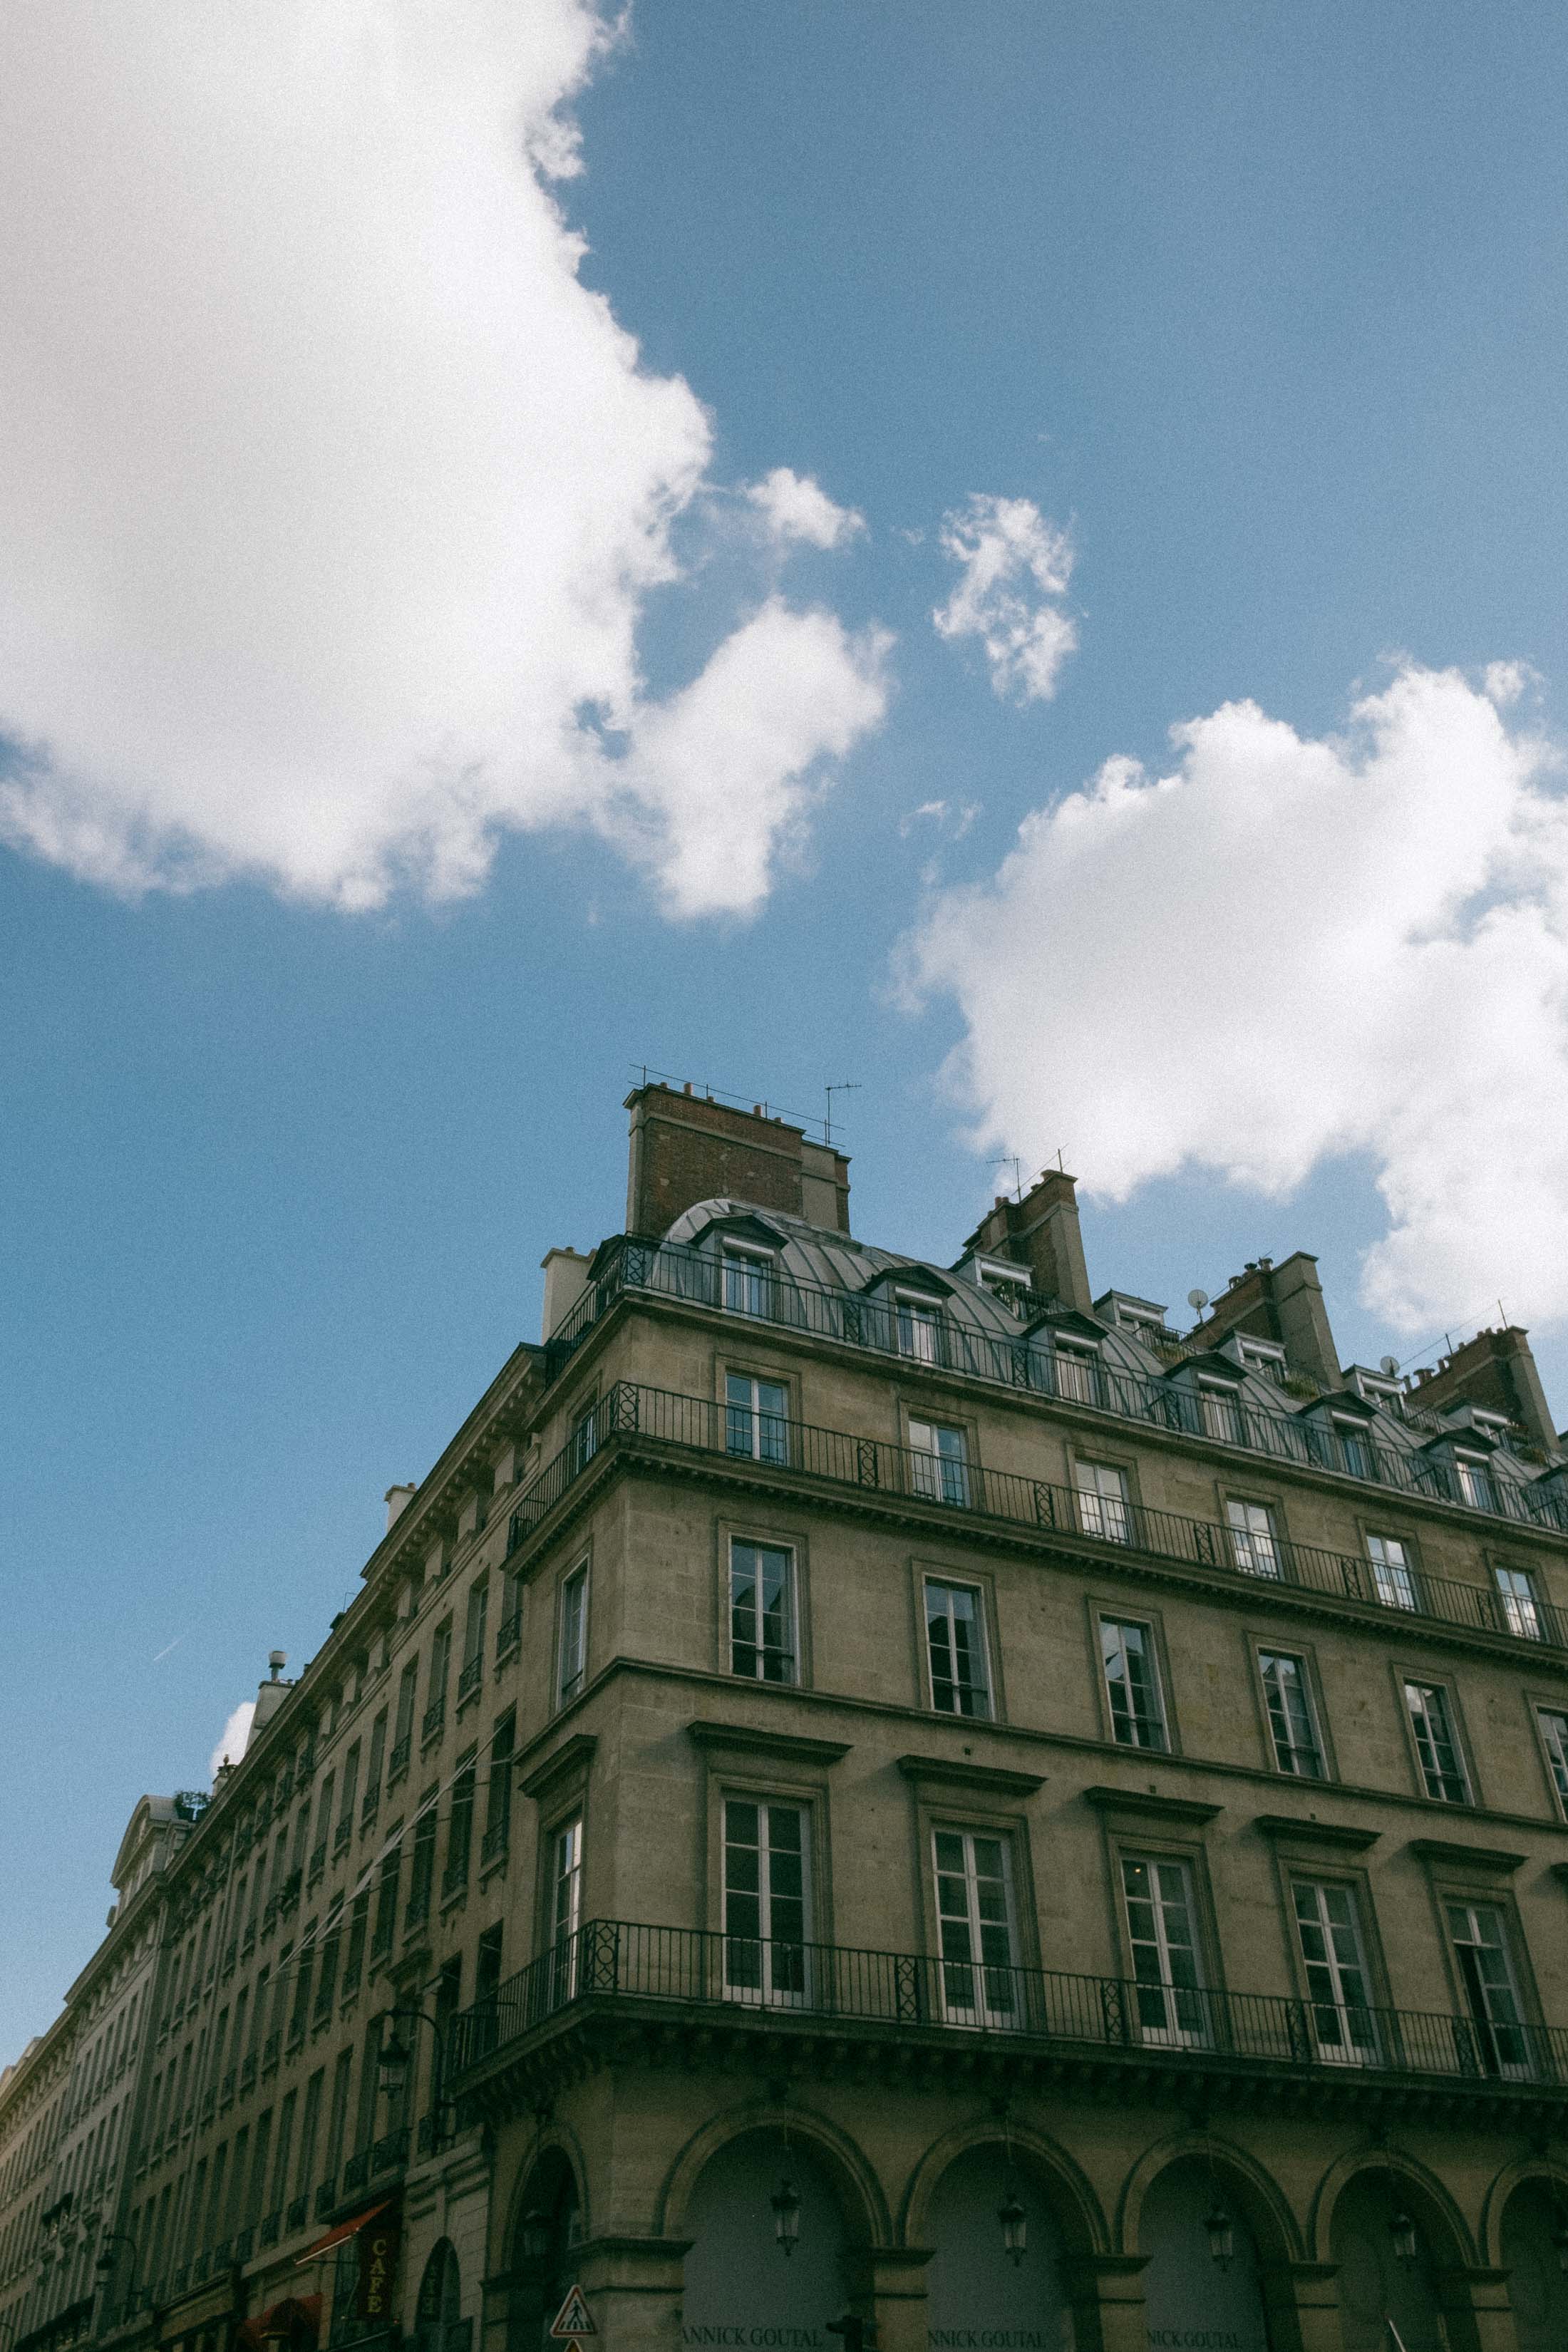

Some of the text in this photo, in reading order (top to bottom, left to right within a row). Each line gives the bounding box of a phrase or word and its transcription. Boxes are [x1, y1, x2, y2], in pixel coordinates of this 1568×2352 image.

[751, 2327, 822, 2347] GOUTAL
[981, 2331, 1046, 2348] GOUTAL
[1184, 2331, 1243, 2348] GOUTAL
